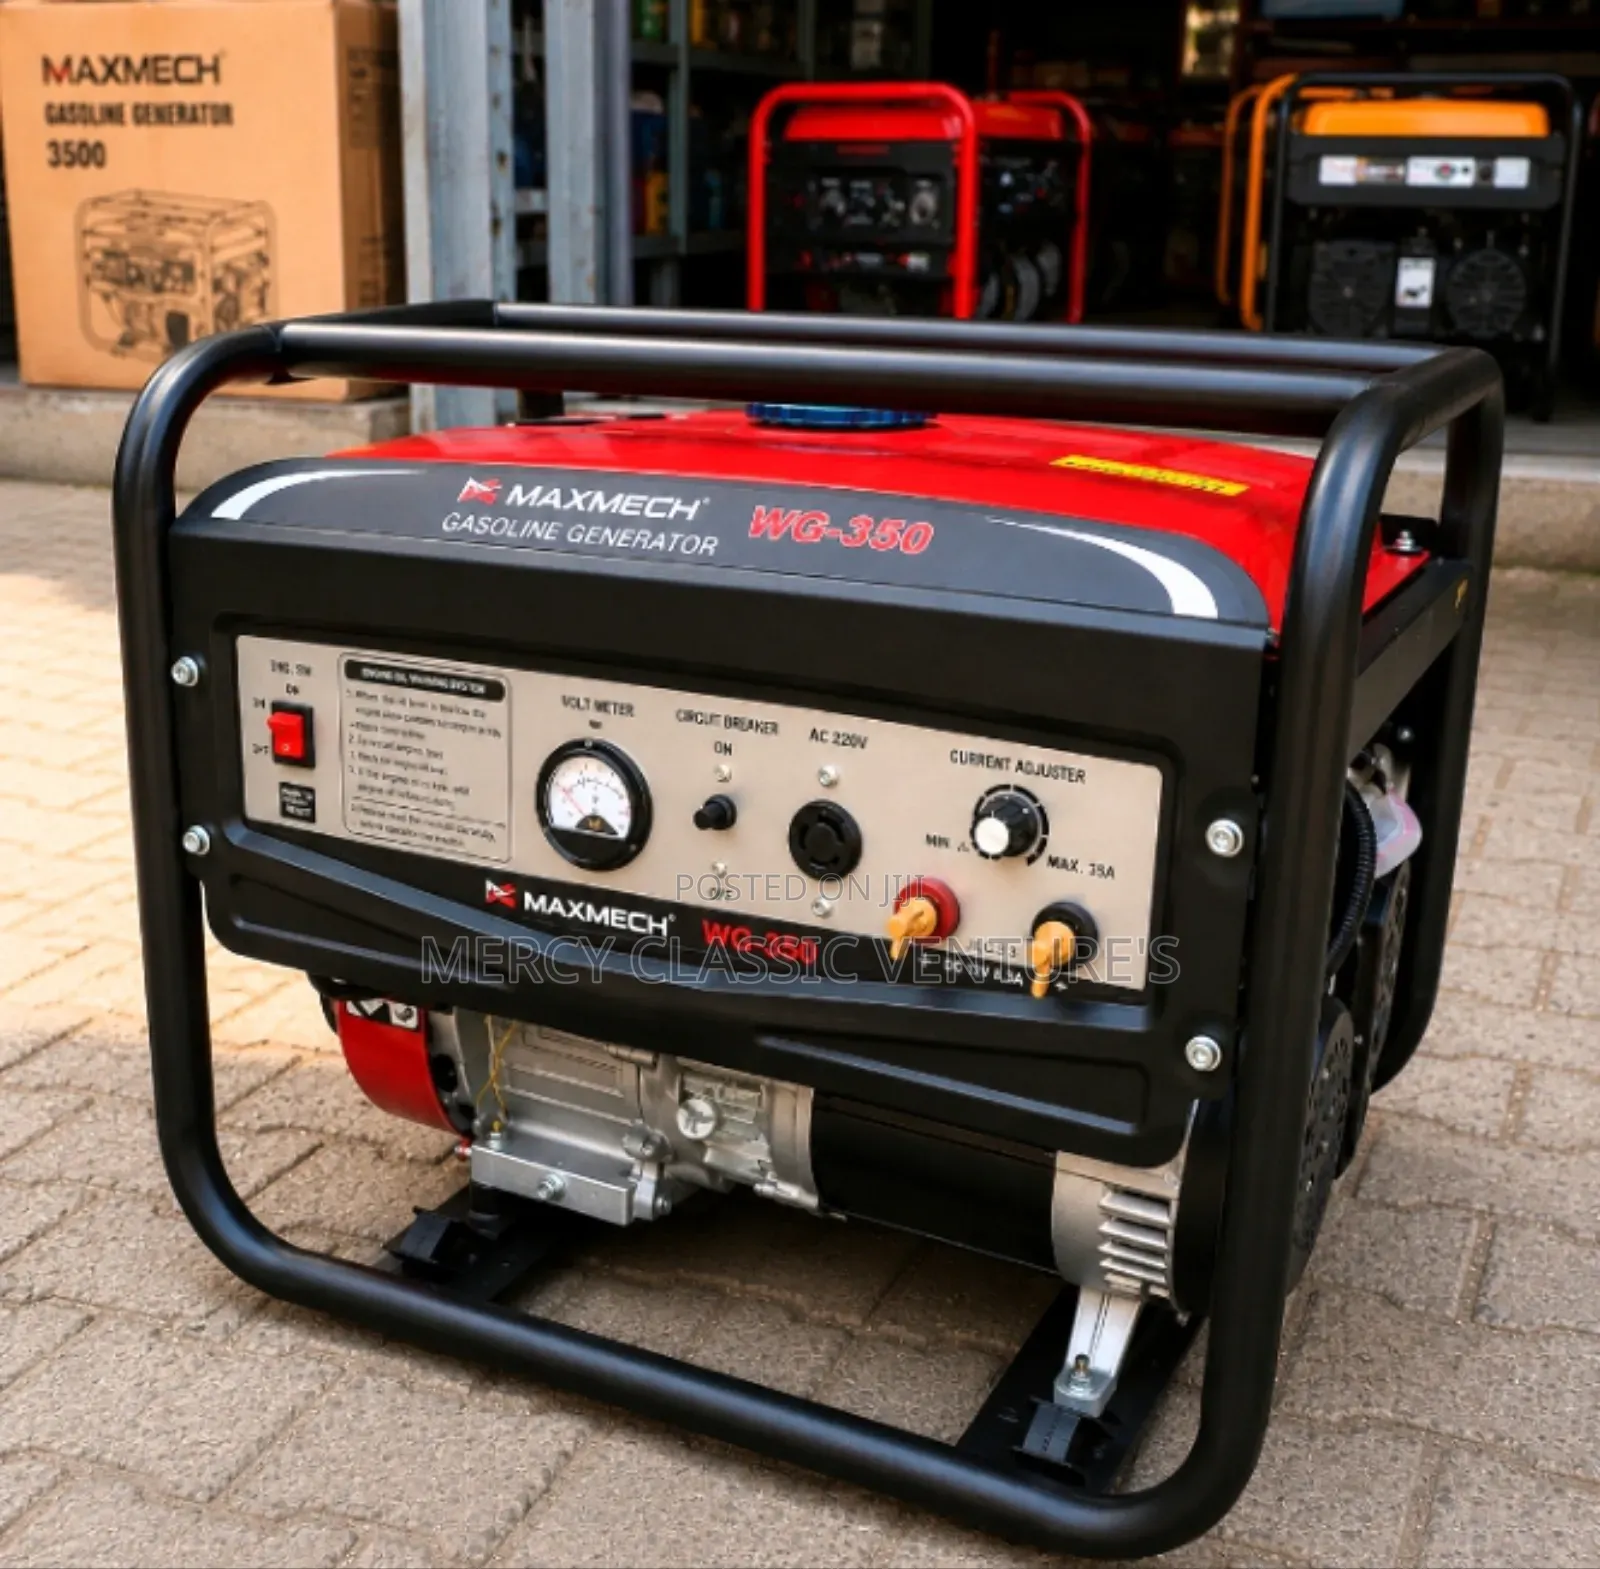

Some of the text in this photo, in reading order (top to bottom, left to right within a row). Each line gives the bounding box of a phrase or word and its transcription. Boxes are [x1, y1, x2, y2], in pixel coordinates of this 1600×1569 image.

[41, 54, 221, 86] MAXMECH
[45, 102, 234, 128] GASOLINE GENERATOR
[47, 140, 107, 169] 3500
[505, 484, 934, 554] MAXMECH WG-350
[441, 512, 719, 557] GASOLINE GENERATOR
[561, 695, 635, 718] VOLT METER
[676, 708, 780, 736] CIRCUIT BREAKER
[714, 741, 732, 757] ON
[809, 728, 868, 750] AC 220V
[950, 749, 1086, 785] CURRENT ADJUSTER
[523, 891, 669, 938] MAXMECH
